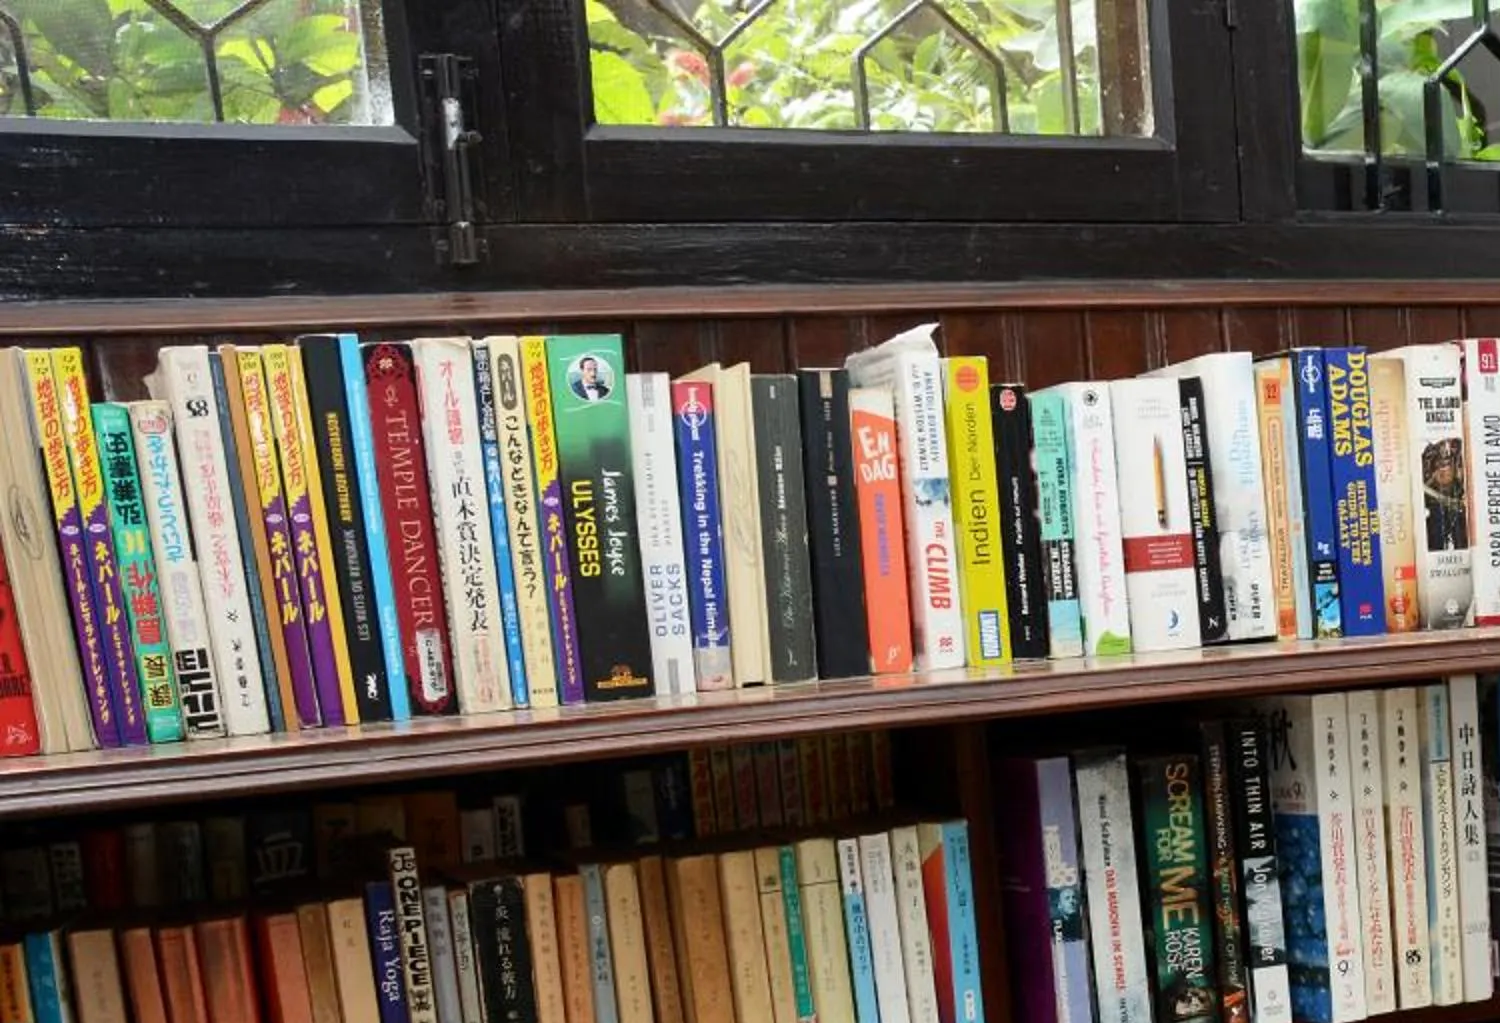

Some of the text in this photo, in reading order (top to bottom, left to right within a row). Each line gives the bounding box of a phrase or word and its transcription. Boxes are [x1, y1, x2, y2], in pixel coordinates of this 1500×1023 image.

[1481, 351, 1497, 370] 91
[1327, 363, 1353, 457] ADAMS
[1347, 352, 1374, 467] DOUGLAS
[1425, 409, 1456, 425] ANGELS
[1483, 414, 1500, 447] AMO
[384, 410, 420, 511] TEMPLE
[693, 451, 712, 511] Trekking
[861, 453, 896, 484] DAG
[969, 402, 991, 566] Indien Der Norden
[546, 510, 569, 592] ネパール
[570, 479, 601, 578] ULYSSES
[600, 468, 629, 577] James Joyce
[698, 514, 712, 527] in
[700, 530, 713, 556] the
[933, 520, 945, 540] THE
[94, 542, 120, 625] ネパール
[271, 531, 300, 625] ネパール
[298, 531, 325, 624] ネパール
[400, 519, 436, 628] DANCER
[649, 564, 669, 638] OLIVER
[666, 561, 688, 637] SACKS
[699, 558, 716, 599] Nepal
[927, 542, 952, 611] CLIMB
[356, 624, 371, 642] LES
[1165, 762, 1197, 866] SCREAM
[1240, 730, 1267, 852] INTO THIN AIR
[1456, 723, 1482, 849] 中日詩人集
[1156, 827, 1174, 864] FOR
[1253, 866, 1273, 892] Jon
[398, 876, 430, 987] ONE PIECE
[1159, 868, 1199, 929] ME
[377, 909, 401, 1002] Raja Yoga
[1168, 930, 1185, 973] ROSE
[1181, 927, 1203, 981] KAREN
